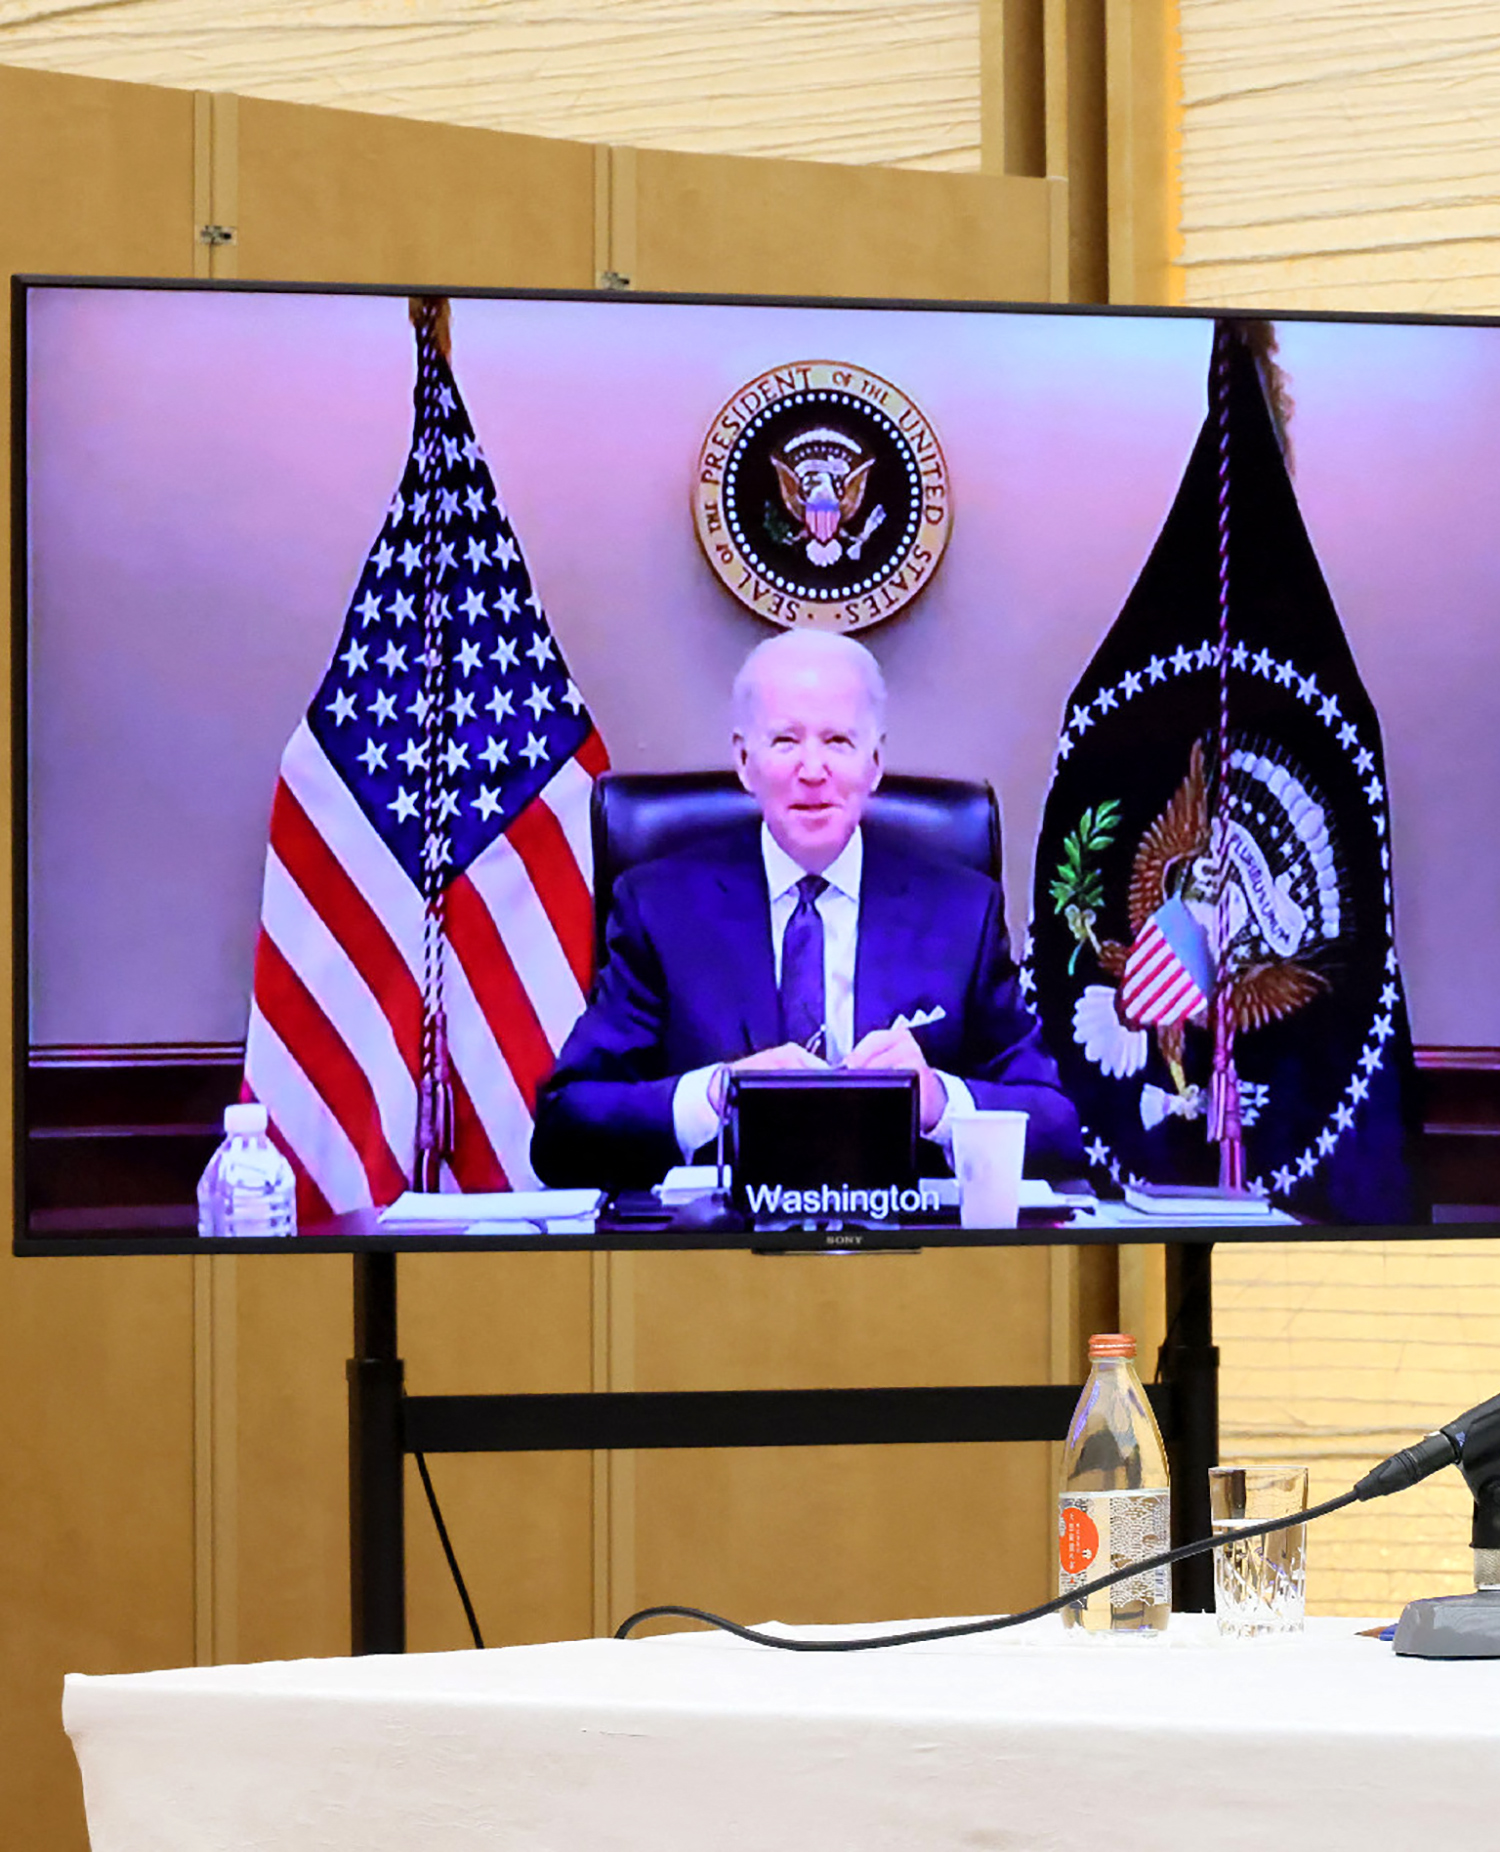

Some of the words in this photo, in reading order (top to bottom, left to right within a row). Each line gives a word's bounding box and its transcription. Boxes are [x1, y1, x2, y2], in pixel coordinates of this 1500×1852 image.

[860, 380, 892, 405] THE
[701, 367, 812, 485] PRESIDENT
[898, 407, 945, 526] UNITED
[704, 504, 722, 532] THE
[738, 567, 801, 622] SEAL
[845, 544, 932, 623] STATES
[745, 1183, 940, 1219] Washington
[826, 1235, 863, 1245] SONY
